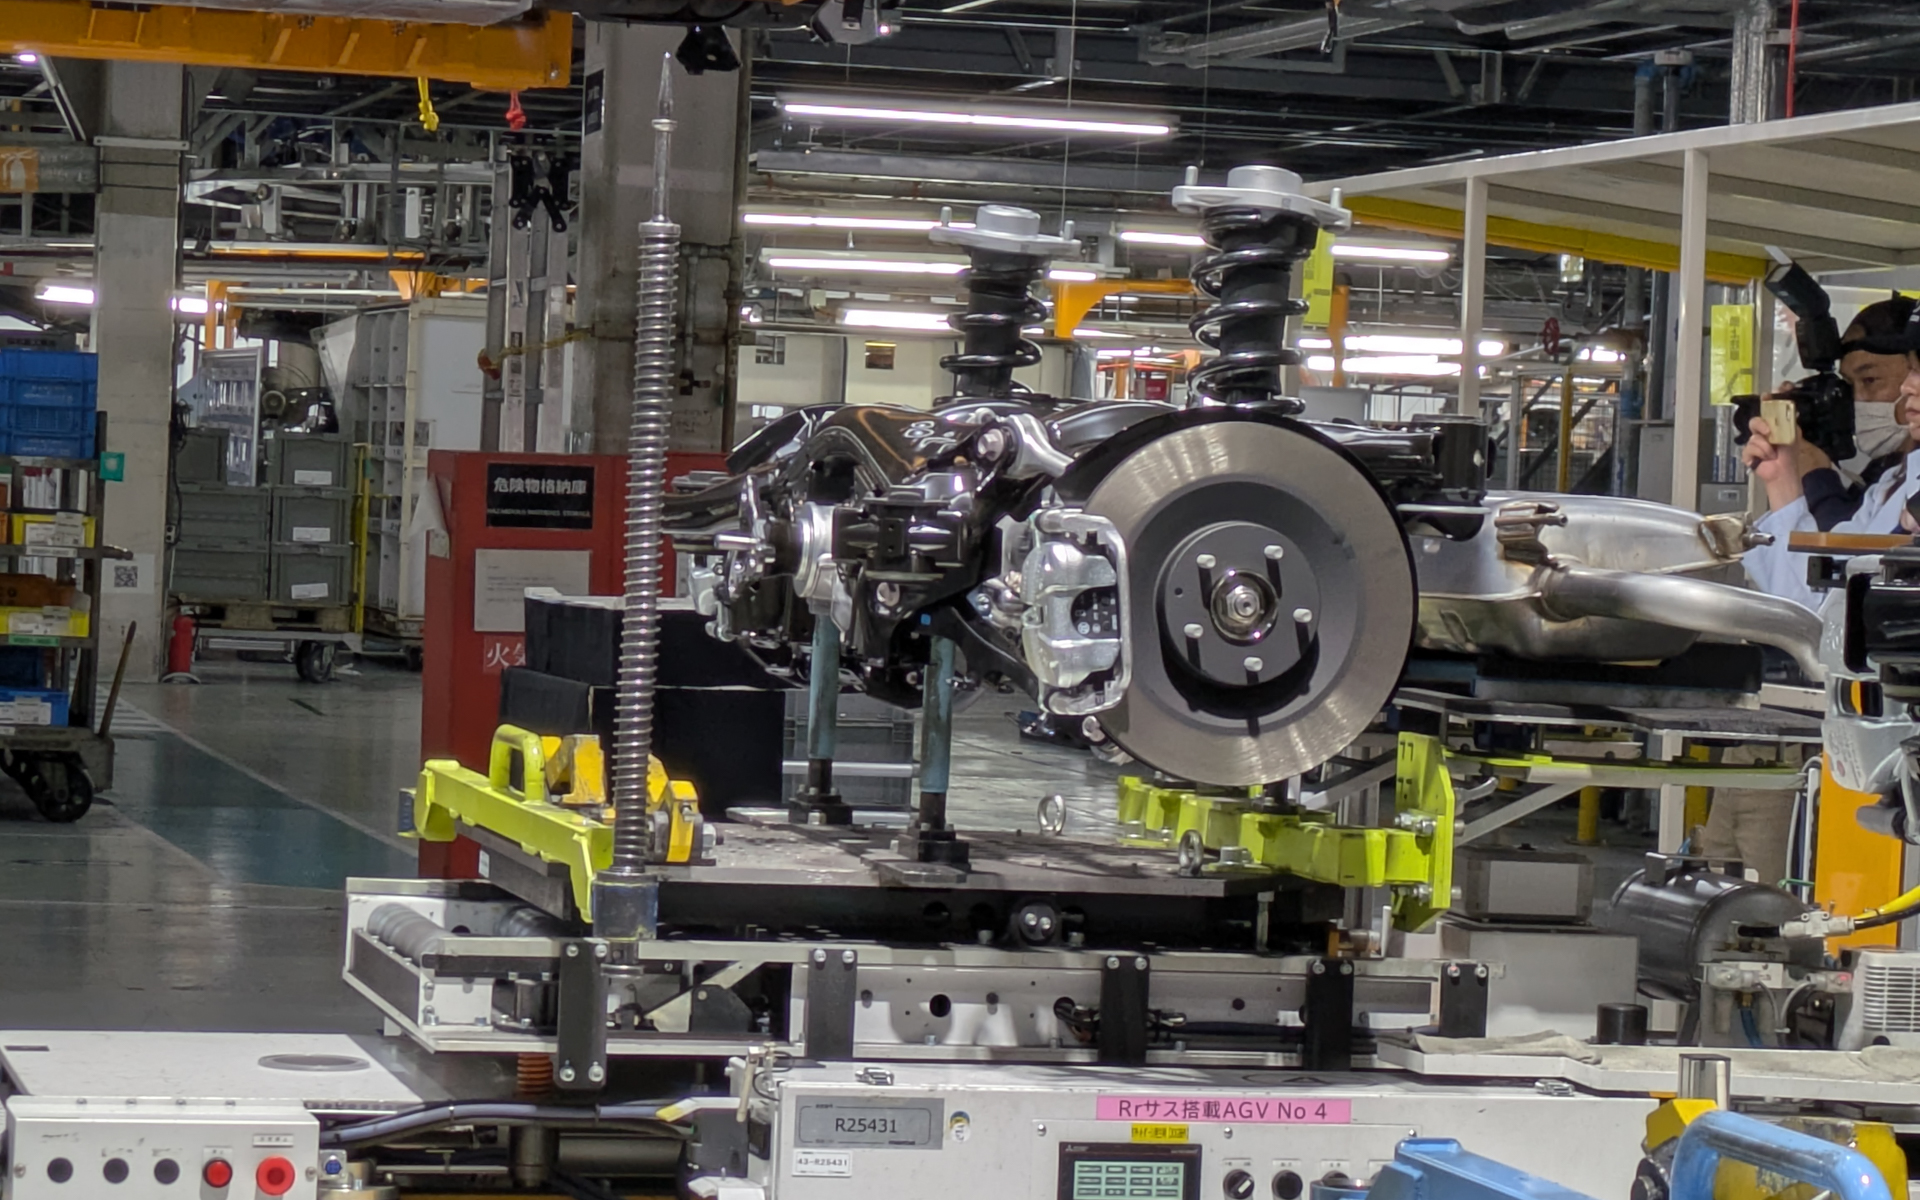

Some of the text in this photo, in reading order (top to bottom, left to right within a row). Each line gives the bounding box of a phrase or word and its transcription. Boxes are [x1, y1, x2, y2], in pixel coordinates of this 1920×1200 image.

[493, 477, 587, 495] 危険物格納庫
[1118, 1099, 1328, 1120] Rrサス搭載AGV No 4
[835, 1117, 898, 1134] R25431
[796, 1157, 848, 1167] 43-R25431
